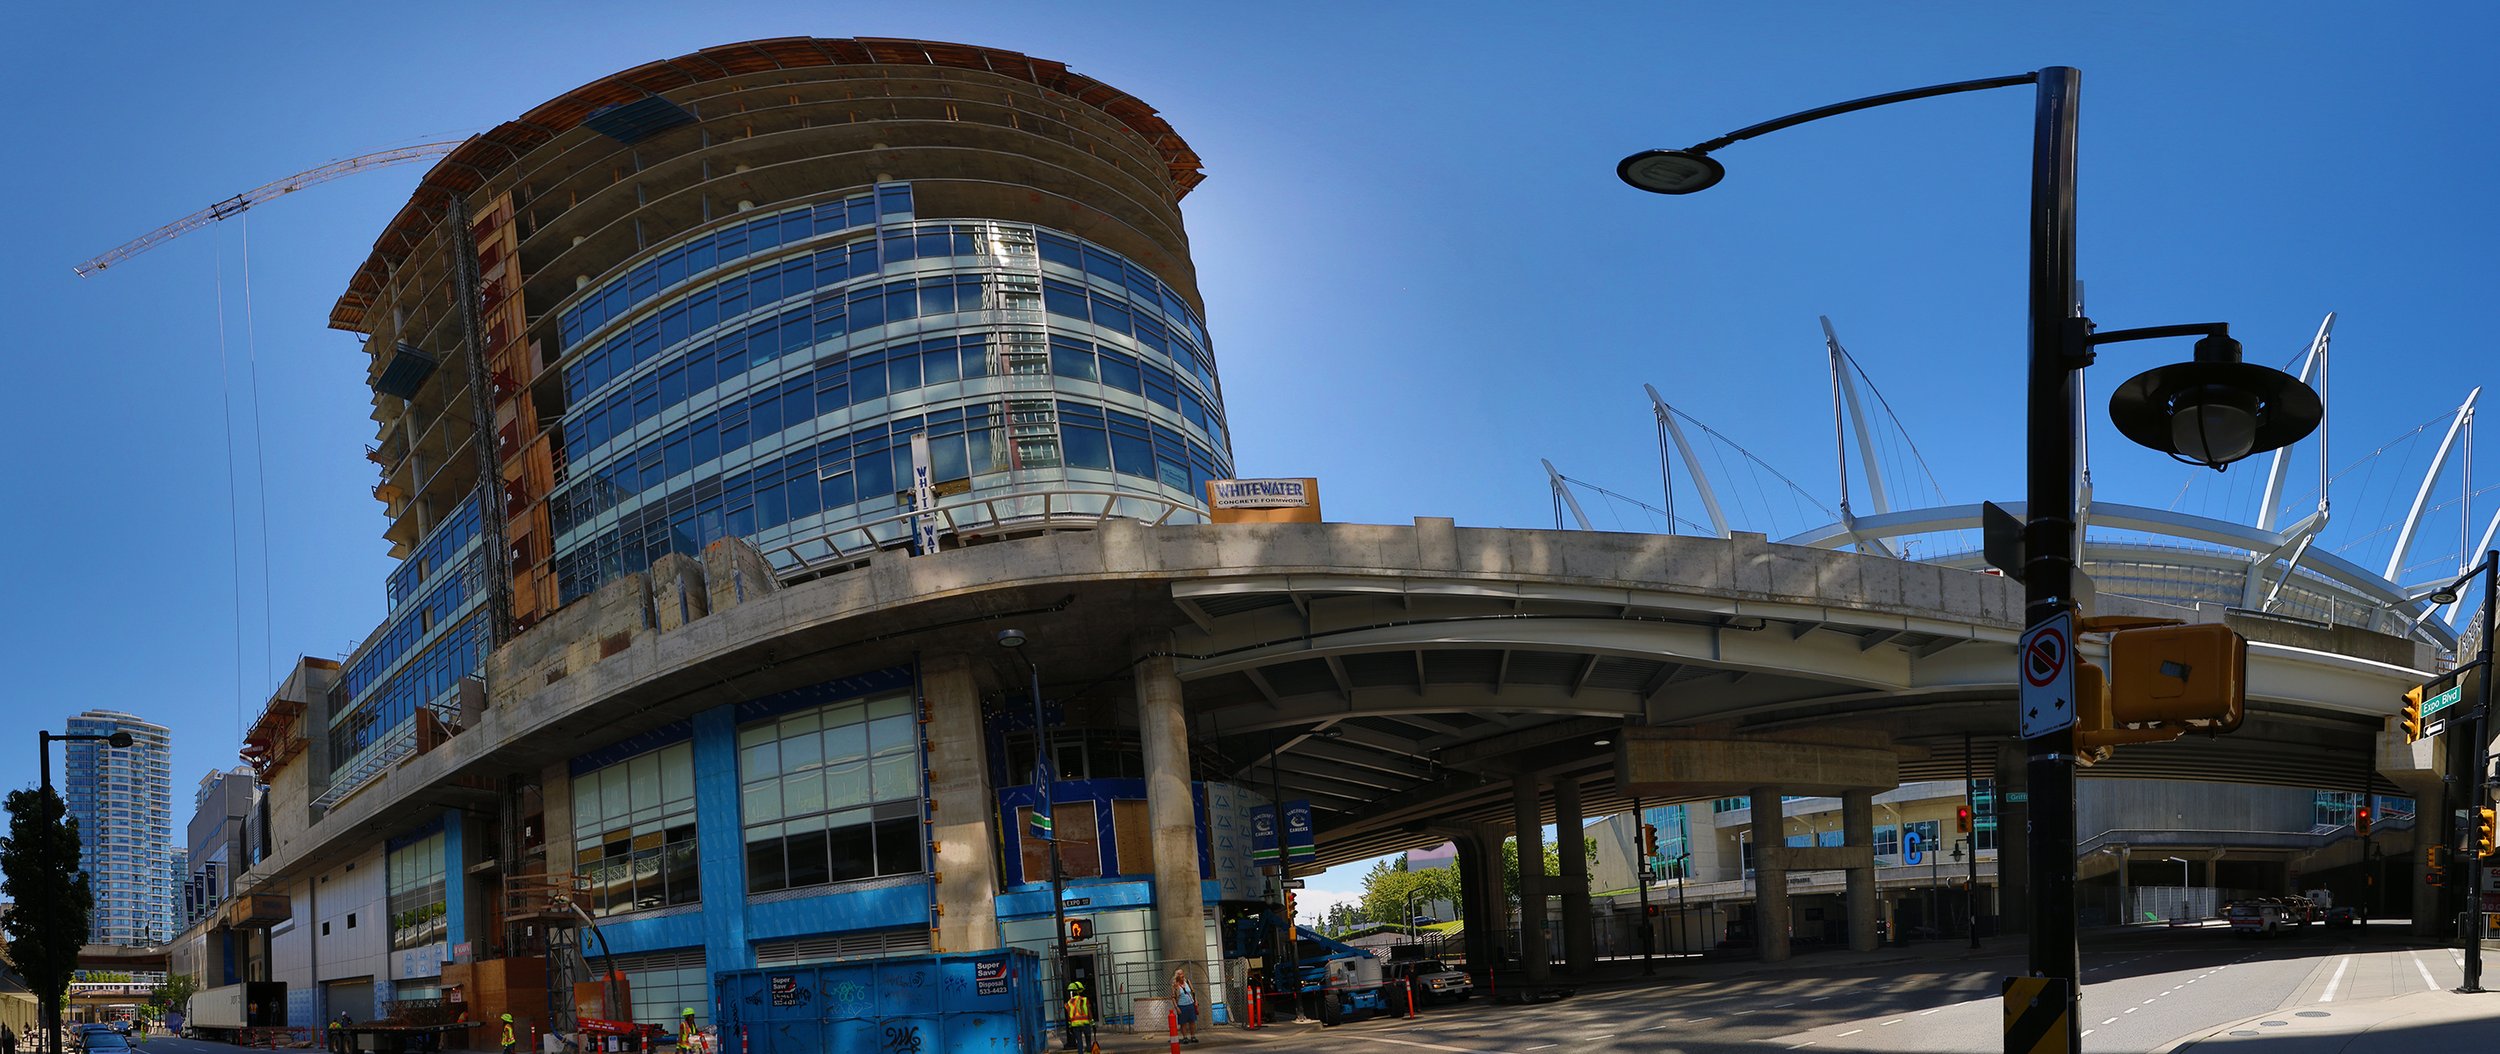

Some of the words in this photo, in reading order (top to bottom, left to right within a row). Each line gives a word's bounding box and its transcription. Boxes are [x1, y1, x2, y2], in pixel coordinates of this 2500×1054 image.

[1215, 480, 1304, 498] WHITEWATER
[2423, 700, 2440, 713] Expo
[2442, 689, 2458, 705] Blvd
[1904, 831, 1922, 865] C
[977, 962, 1000, 970] Super
[978, 969, 997, 977] Save
[978, 979, 1004, 988] Disposal
[979, 986, 1008, 995] 533-4423
